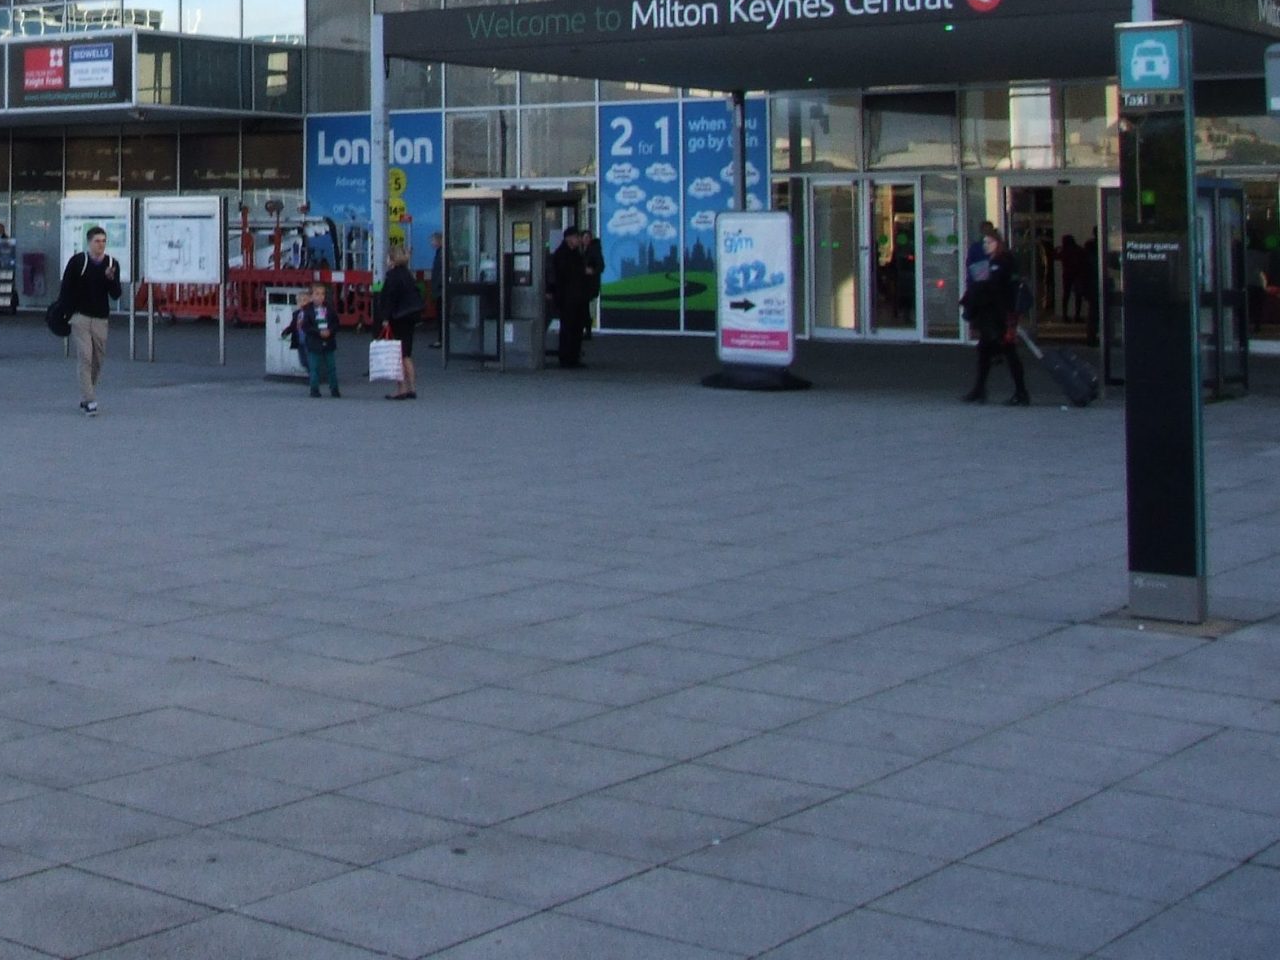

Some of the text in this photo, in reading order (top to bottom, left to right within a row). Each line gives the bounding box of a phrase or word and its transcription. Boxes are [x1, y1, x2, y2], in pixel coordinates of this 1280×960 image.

[467, 8, 586, 39] Welcome
[595, 6, 620, 32] to
[1123, 92, 1149, 107] Taxi
[688, 115, 726, 131] when
[610, 115, 669, 156] 2 for 1
[688, 138, 706, 153] go
[708, 133, 725, 152] by
[723, 237, 754, 254] gym
[1126, 242, 1179, 252] Please queue
[1148, 251, 1166, 260] here
